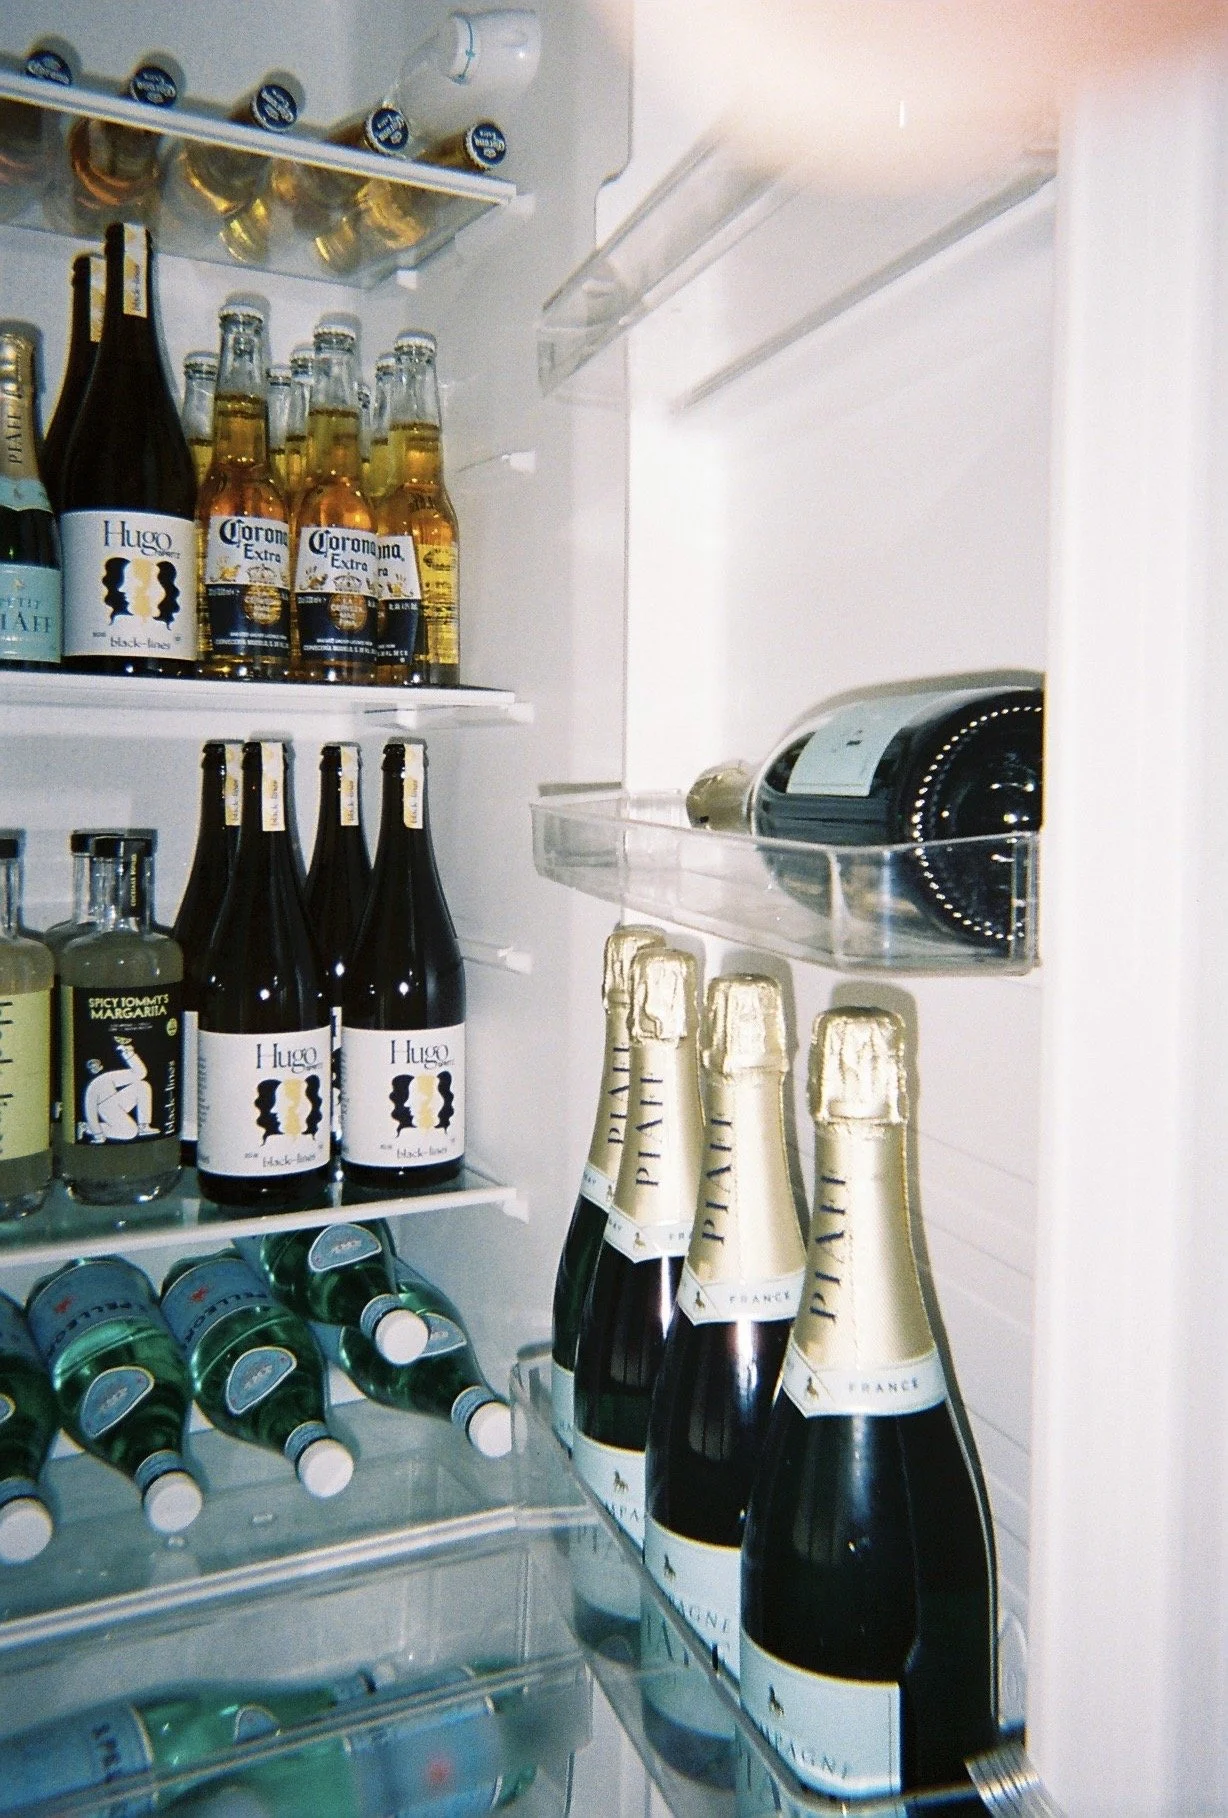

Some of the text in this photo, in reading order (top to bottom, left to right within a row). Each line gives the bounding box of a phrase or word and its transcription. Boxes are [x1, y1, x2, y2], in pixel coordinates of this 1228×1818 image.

[103, 519, 173, 556] Hugo
[219, 518, 288, 547] Corona
[308, 529, 377, 558] Corona
[243, 543, 281, 564] Extra
[330, 553, 368, 572] Extra
[0, 610, 52, 634] IAFF
[88, 997, 120, 1008] SPICY
[90, 1005, 168, 1020] MARGARITA
[256, 1042, 318, 1074] Hugo
[389, 1039, 449, 1070] Hugo
[164, 1060, 176, 1135] black-lines
[701, 1111, 732, 1245] PIAFF
[809, 1168, 847, 1324] PIAFF
[729, 1290, 790, 1304] FRANCE
[848, 1375, 919, 1393] FRANCE
